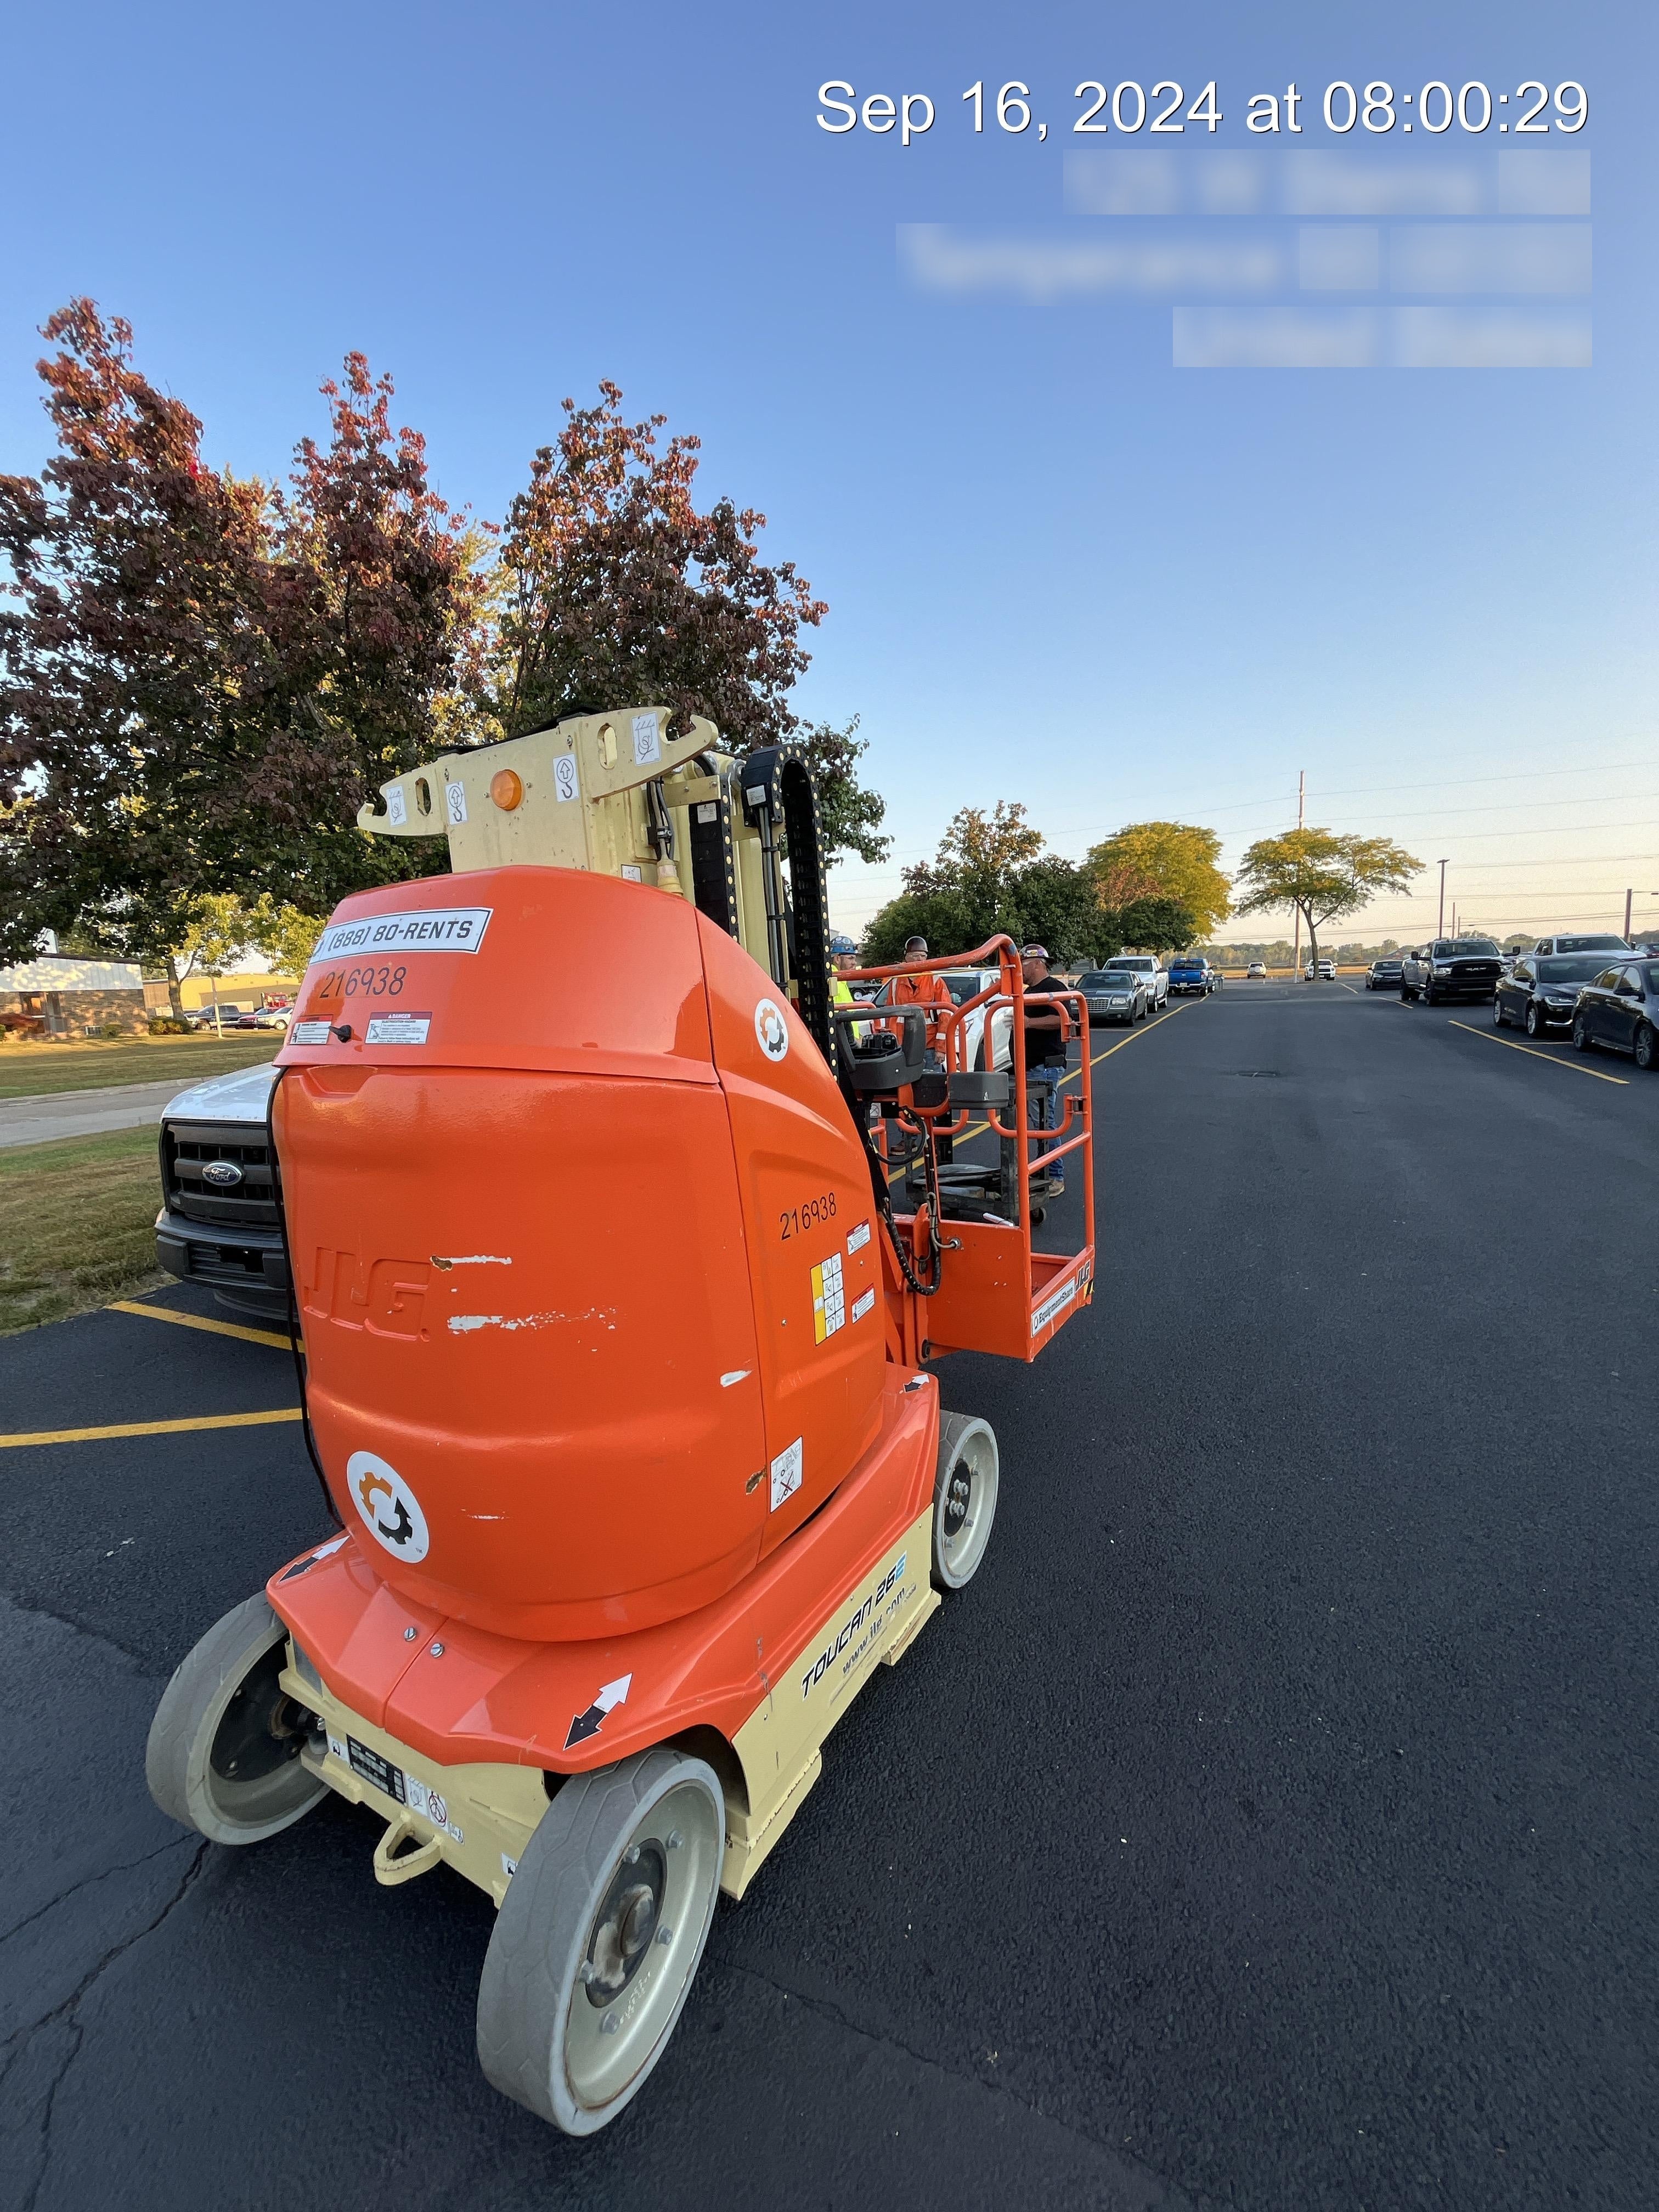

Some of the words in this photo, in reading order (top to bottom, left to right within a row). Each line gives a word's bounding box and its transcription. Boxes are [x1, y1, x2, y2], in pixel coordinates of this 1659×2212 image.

[328, 926, 371, 952] (888)
[373, 920, 473, 942] 80-RENTS
[319, 966, 407, 998] 216938
[210, 1167, 231, 1181] Ford
[780, 1192, 837, 1241] 216938
[801, 1595, 873, 1700] TOUCAN
